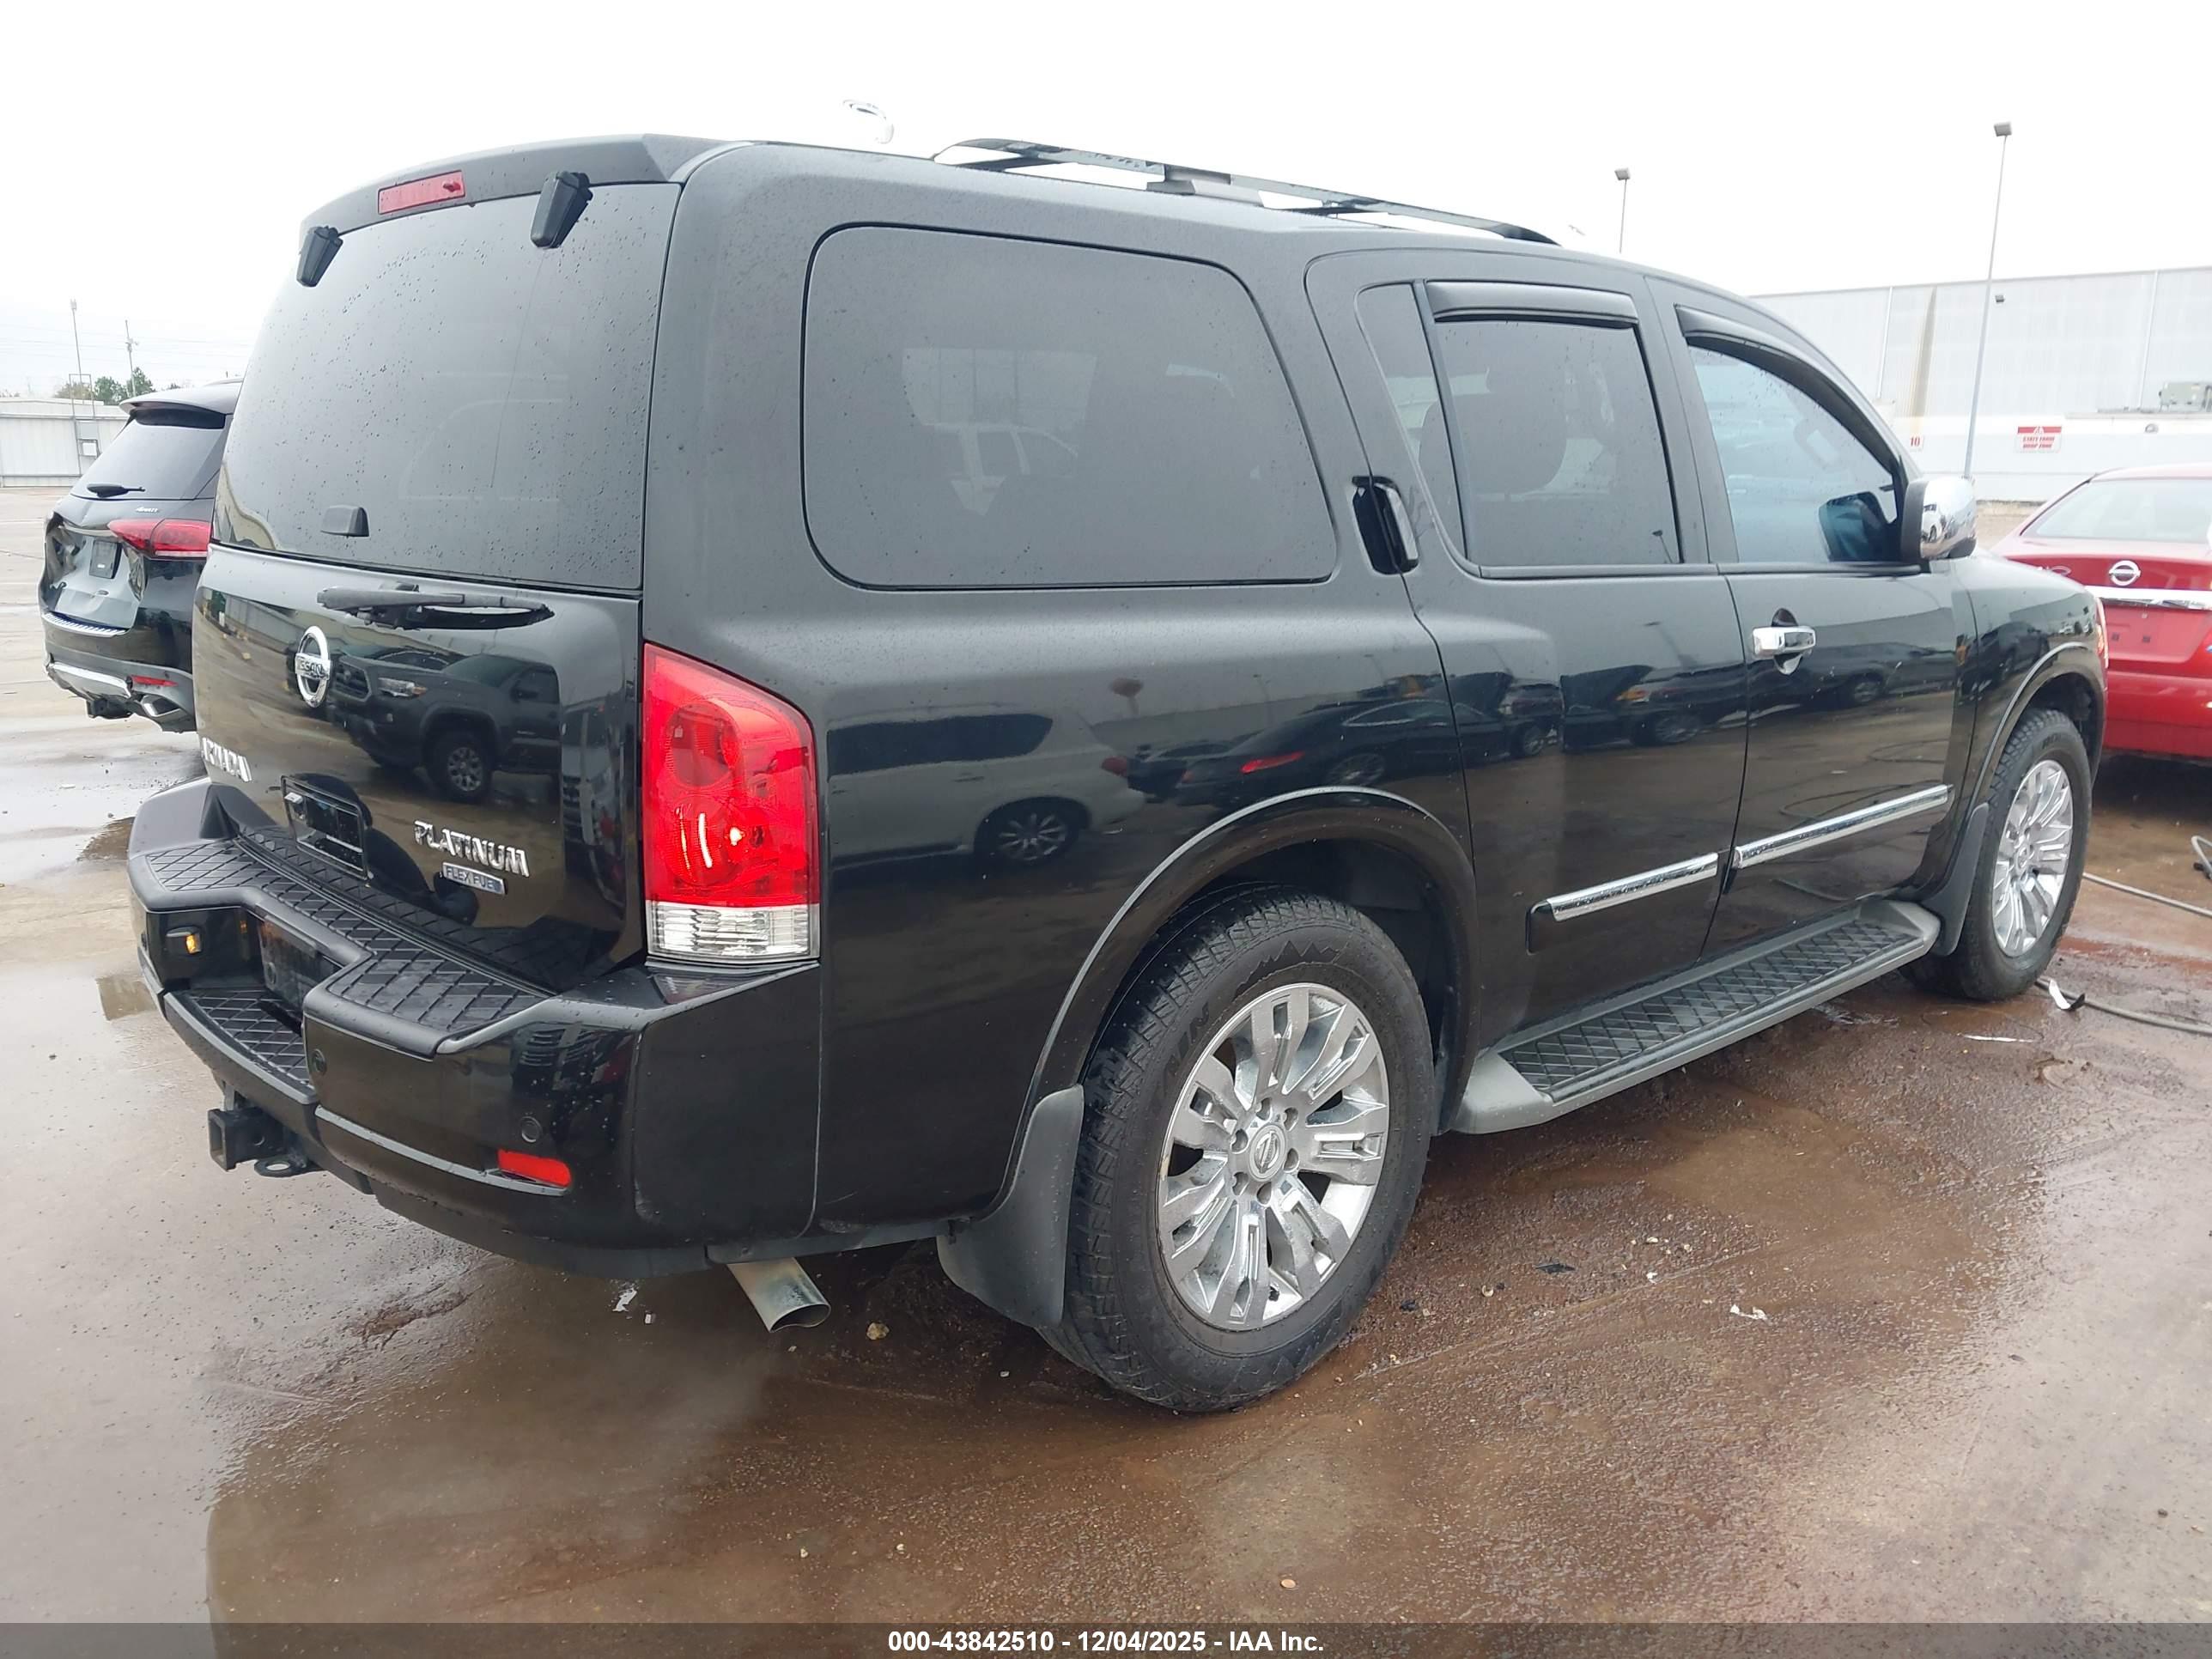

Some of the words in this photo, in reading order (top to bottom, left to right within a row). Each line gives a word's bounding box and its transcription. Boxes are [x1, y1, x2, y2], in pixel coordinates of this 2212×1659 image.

[1910, 436, 1921, 447] 10
[414, 820, 530, 878] PLATINUM
[446, 866, 472, 884] FLEX
